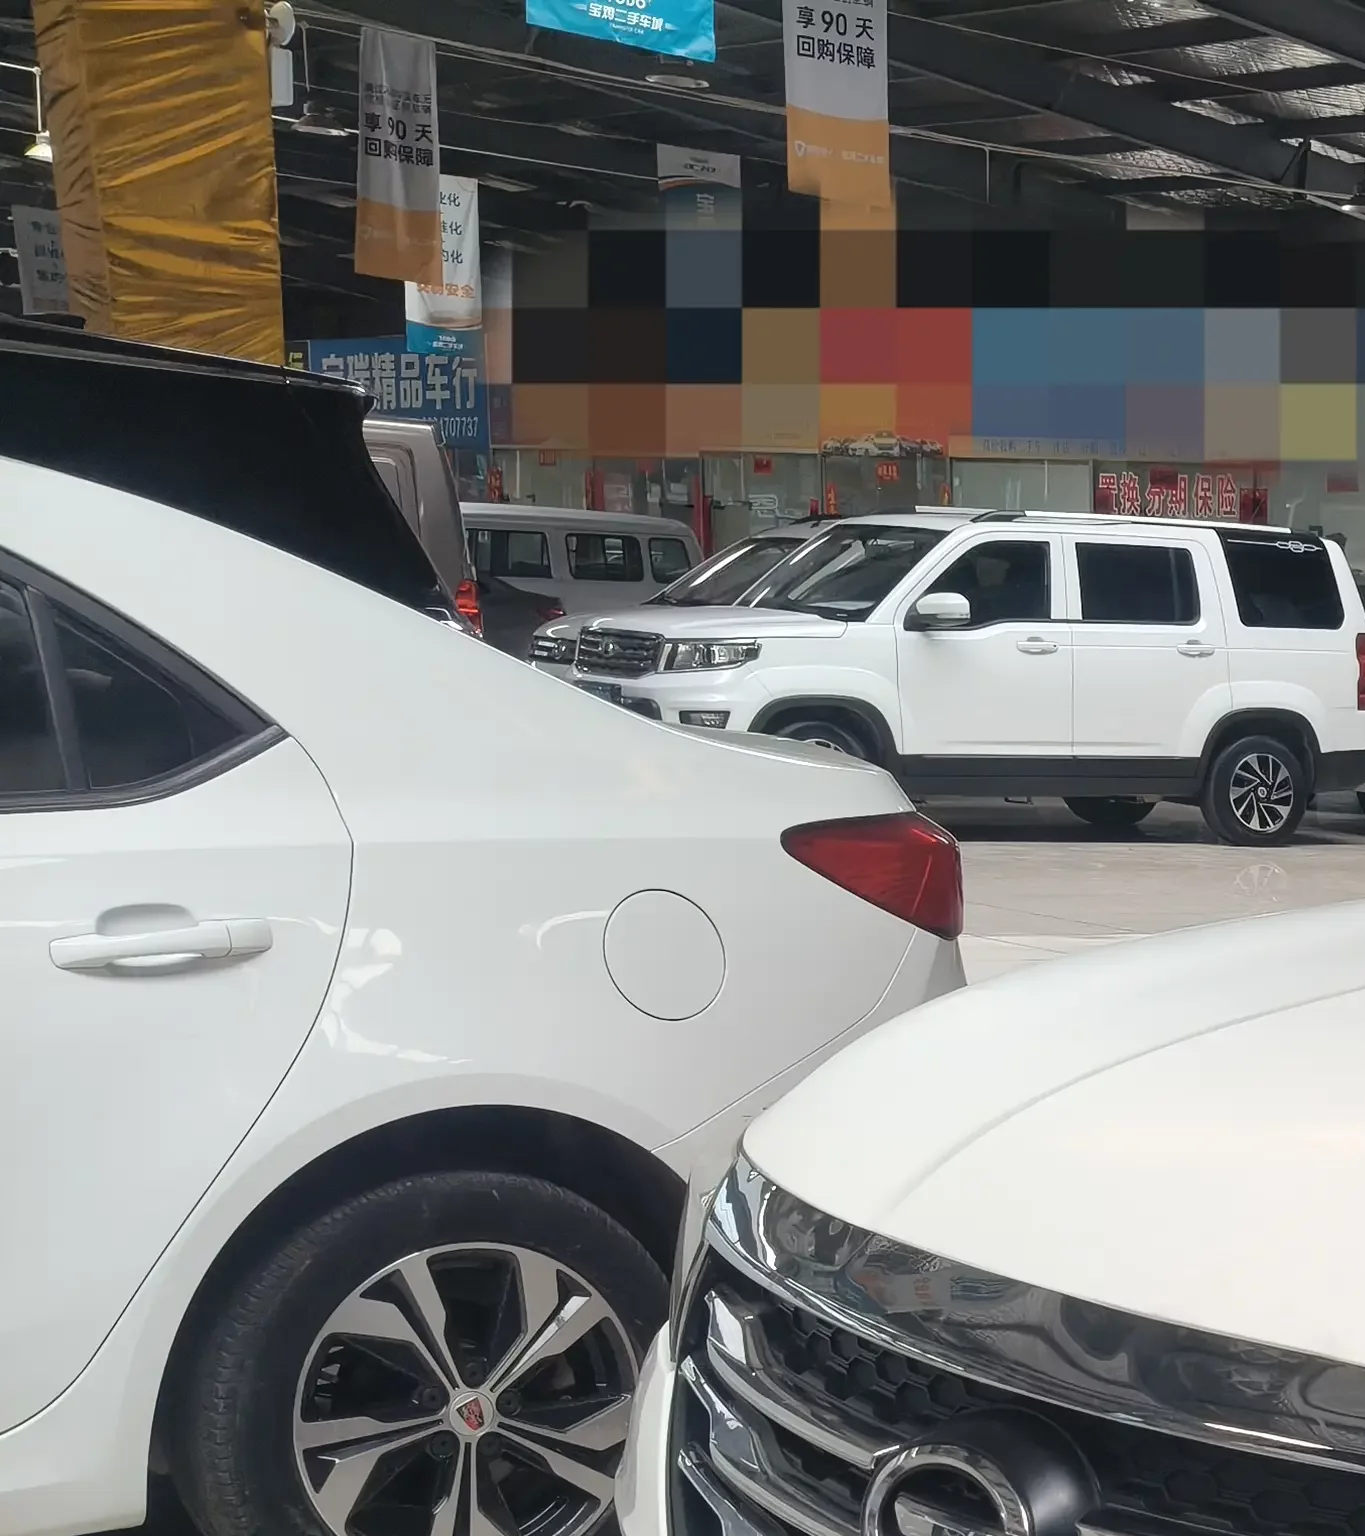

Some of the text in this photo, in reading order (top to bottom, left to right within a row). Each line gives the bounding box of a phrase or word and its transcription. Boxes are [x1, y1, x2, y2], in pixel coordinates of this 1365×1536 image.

[588, 3, 665, 31] 宝鸡二手车城
[796, 6, 875, 41] 享 90 天
[796, 35, 876, 69] 回购保障
[364, 111, 434, 145] 享 90 天
[364, 137, 434, 167] 回购保障
